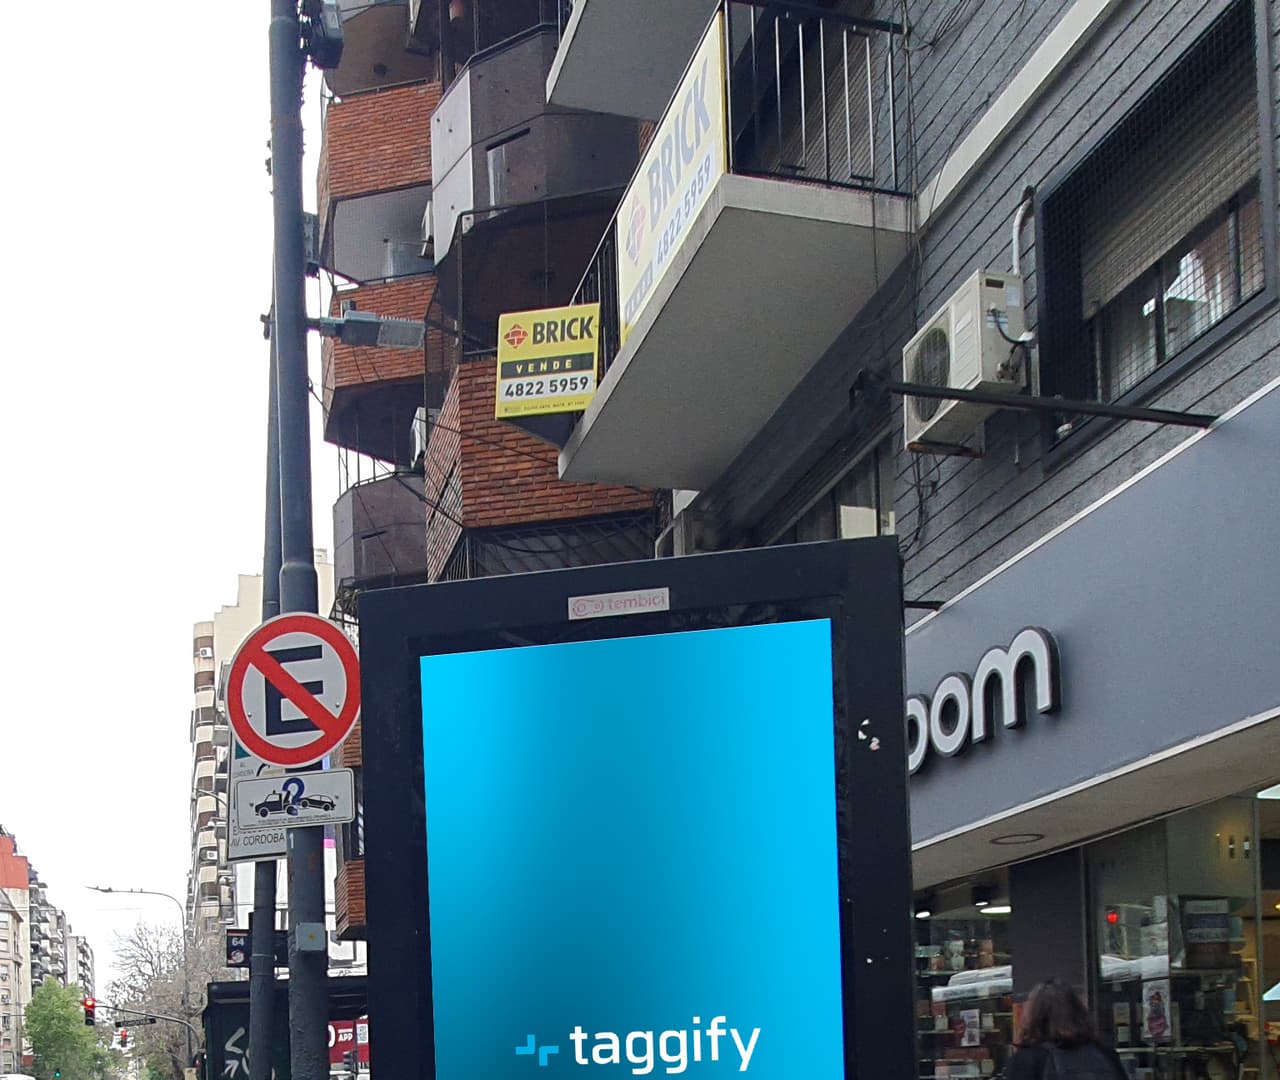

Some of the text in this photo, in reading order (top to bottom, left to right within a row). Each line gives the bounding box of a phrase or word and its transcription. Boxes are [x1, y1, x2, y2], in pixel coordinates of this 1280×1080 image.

[647, 56, 711, 232] BRICK
[657, 154, 711, 265] 4822 5959
[532, 315, 594, 345] BRICK
[516, 359, 573, 374] VENDE
[505, 376, 589, 398] 4822 5959
[608, 592, 665, 611] tembici
[263, 645, 324, 736] E
[243, 832, 285, 847] CORDOBA
[231, 937, 245, 947] 64
[338, 1033, 353, 1042] APP
[570, 1015, 761, 1075] taggify
